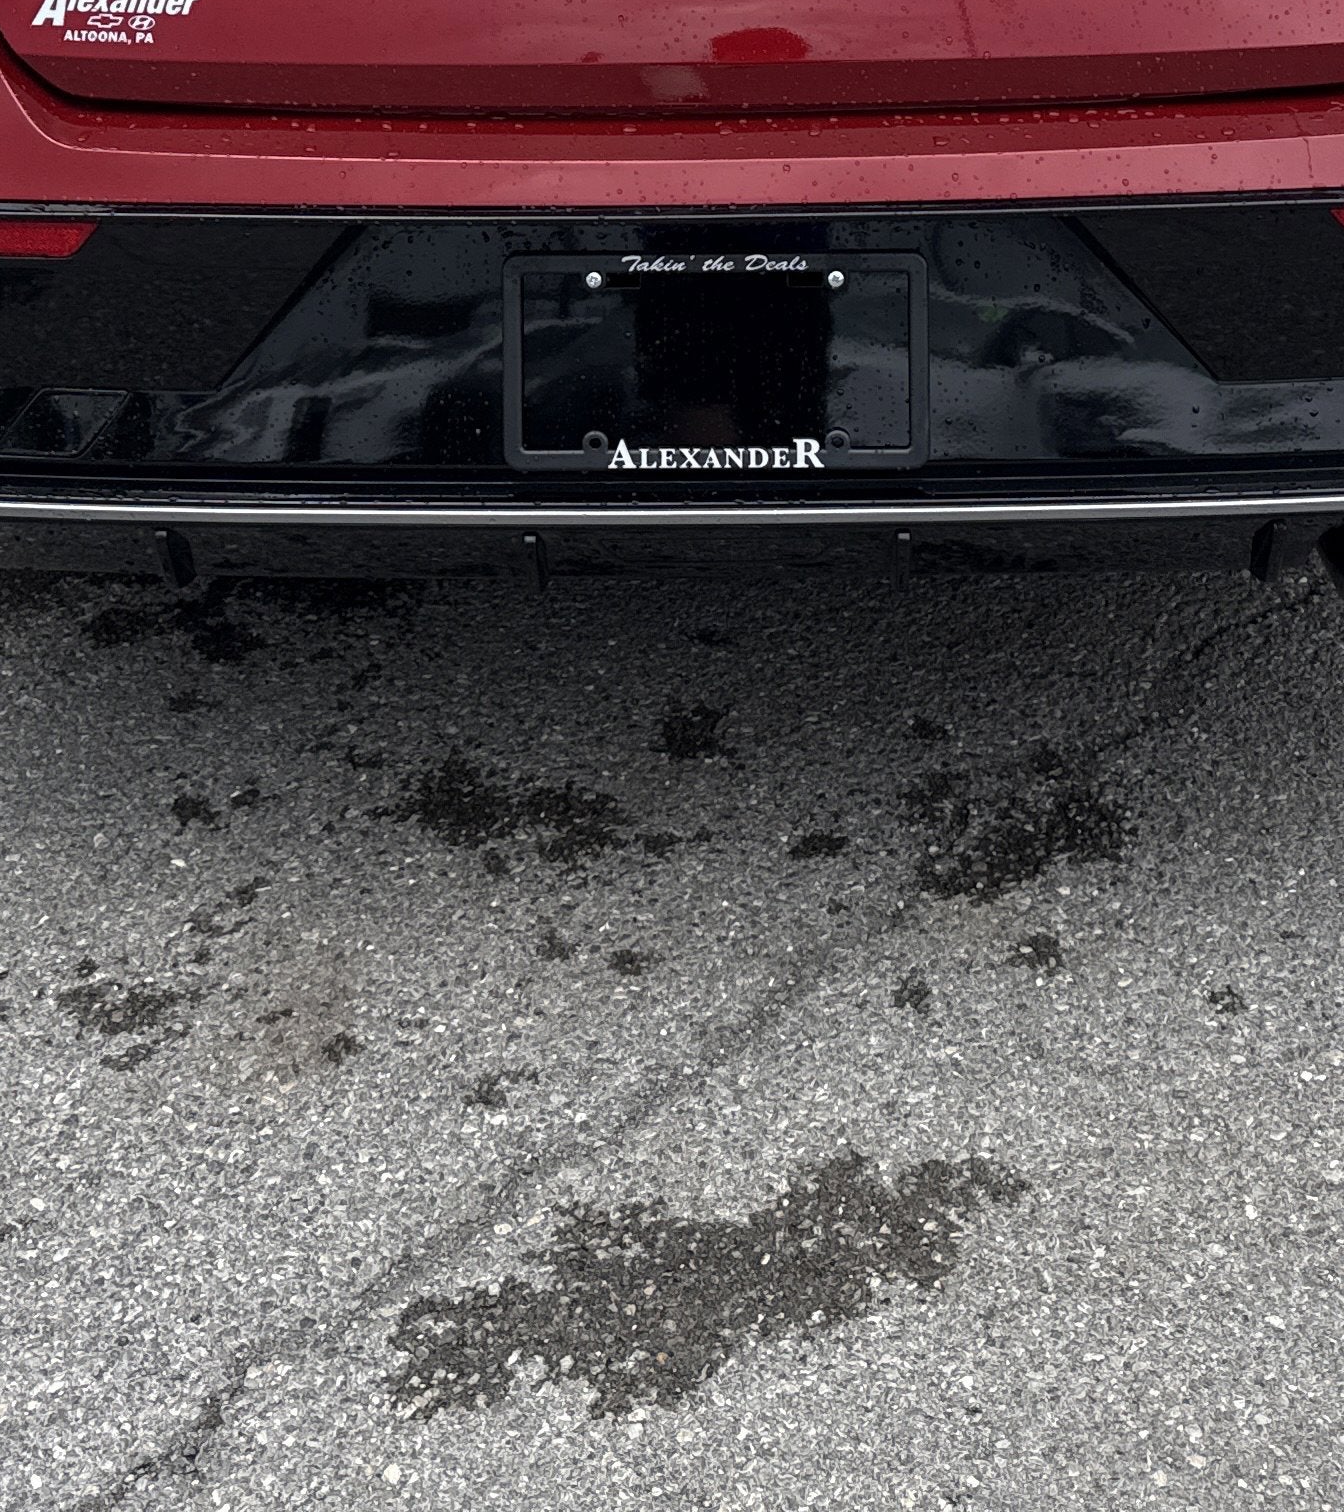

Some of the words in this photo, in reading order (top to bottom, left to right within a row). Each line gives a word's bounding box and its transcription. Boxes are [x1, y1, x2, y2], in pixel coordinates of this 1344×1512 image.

[63, 30, 132, 45] ALTOONA,
[135, 32, 155, 44] PA
[621, 254, 696, 273] Takin'
[701, 255, 735, 272] the
[744, 254, 810, 272] Deals
[608, 437, 825, 469] ALEXANDER
